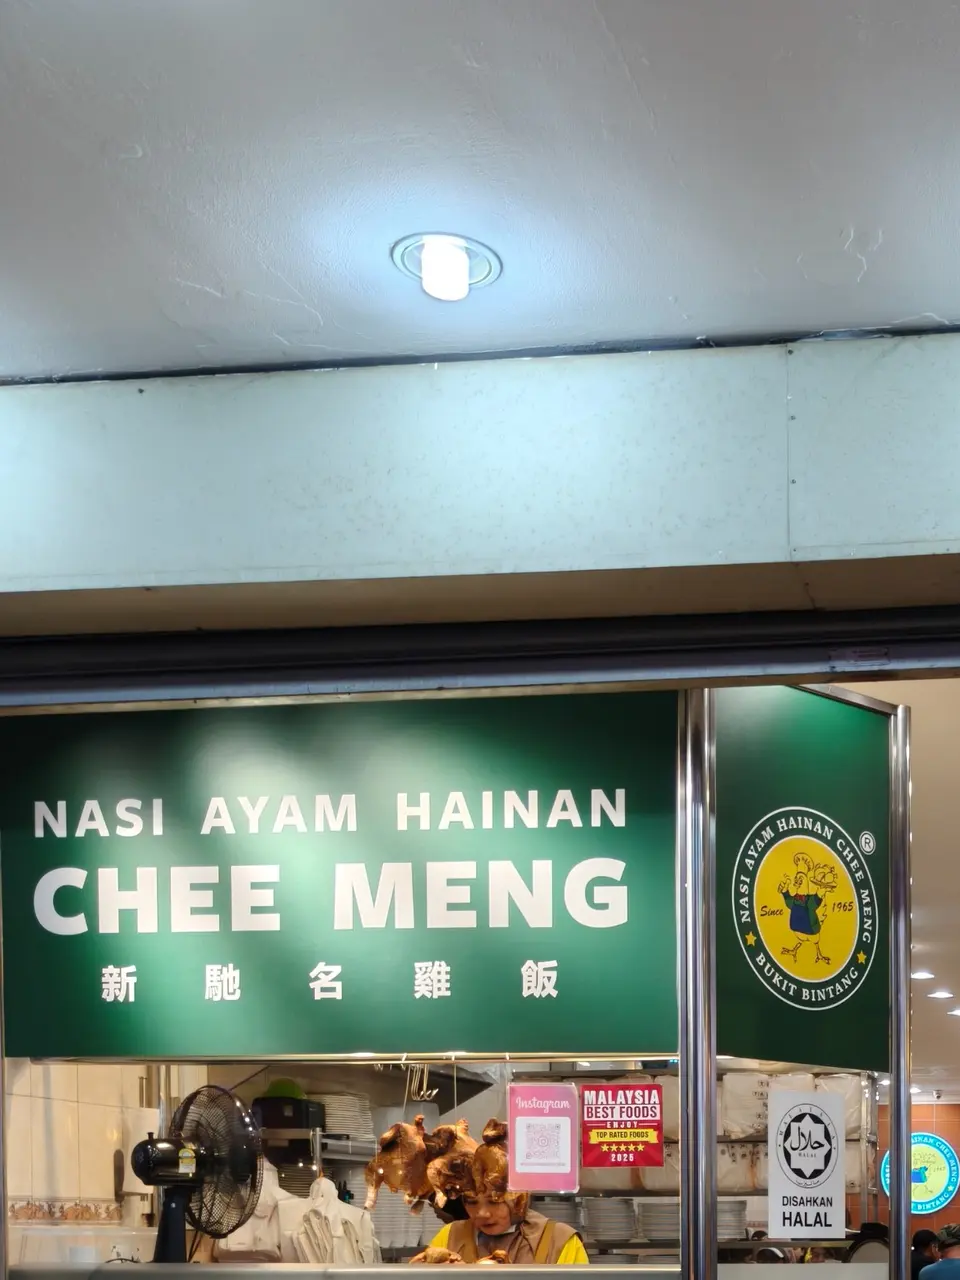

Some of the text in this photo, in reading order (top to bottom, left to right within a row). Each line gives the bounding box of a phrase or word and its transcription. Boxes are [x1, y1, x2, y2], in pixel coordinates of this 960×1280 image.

[34, 788, 627, 838] NASI AYAM HAINAN
[739, 816, 873, 943] NASI AYAM HAINAN CHEE MENG
[33, 858, 628, 935] CHEE MENG
[760, 901, 854, 917] Since 1965
[101, 960, 559, 1003] 新馳名雞飯
[755, 952, 858, 1001] BUKIT BINTANG
[515, 1097, 571, 1113] Instagram
[584, 1089, 660, 1105] MALAYSIA
[586, 1106, 658, 1119] BEST FOODS
[611, 1153, 634, 1162] 2025
[782, 1196, 833, 1207] DISAHKAN
[782, 1212, 832, 1227] HALAL
